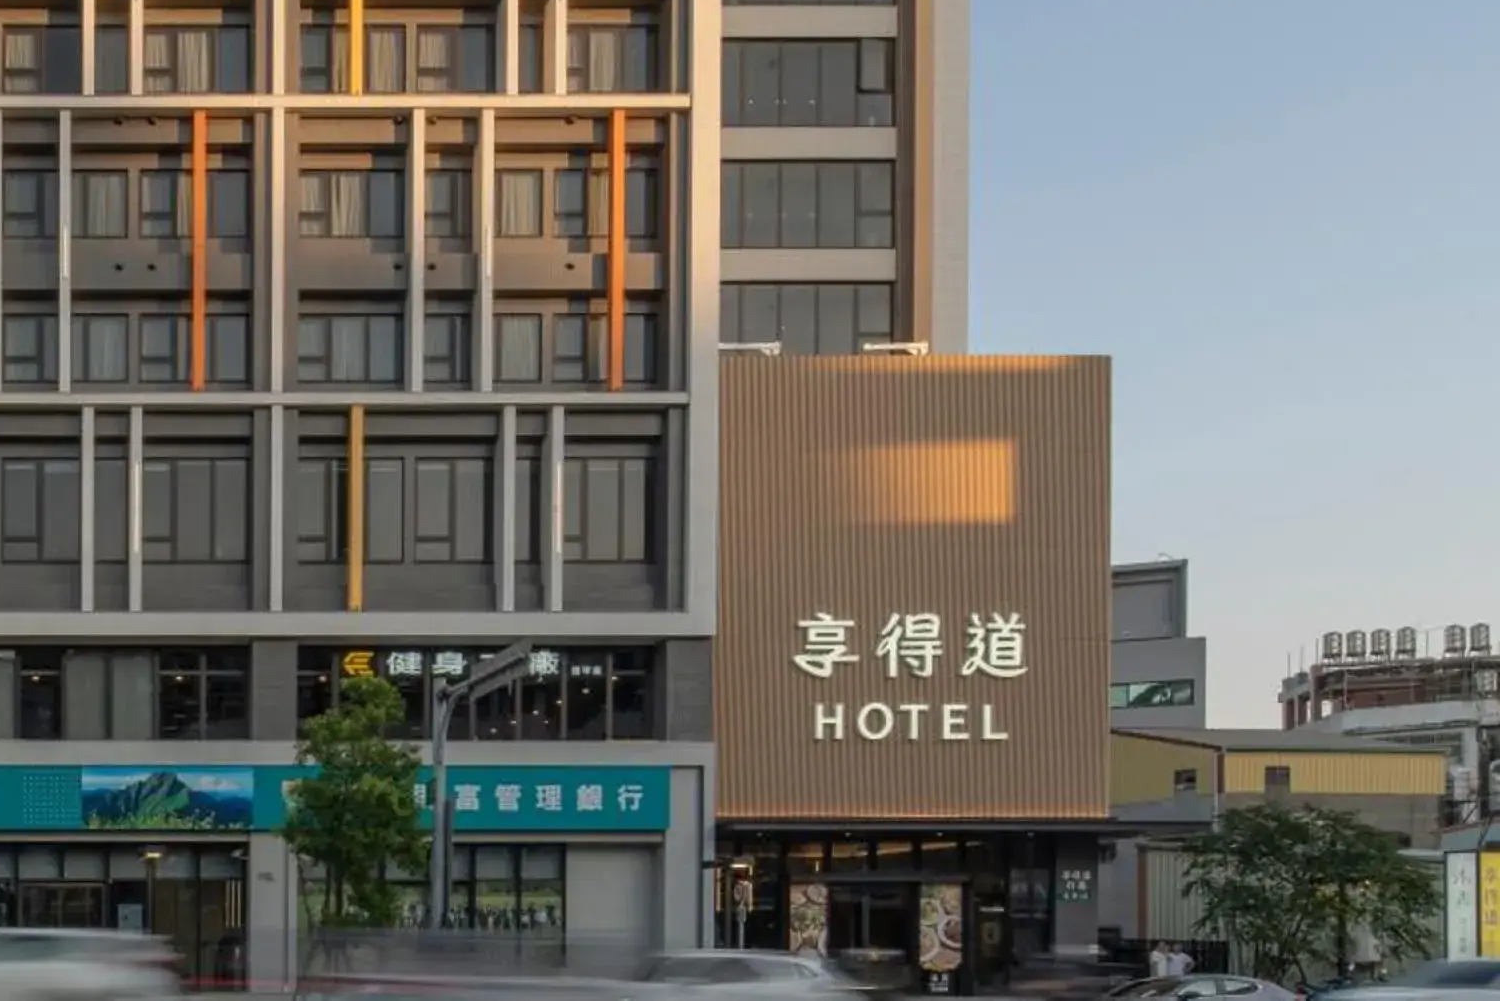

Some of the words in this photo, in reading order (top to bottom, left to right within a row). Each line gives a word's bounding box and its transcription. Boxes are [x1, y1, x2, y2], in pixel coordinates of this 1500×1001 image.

[386, 650, 560, 676] 健身廠
[793, 612, 1028, 678] 享得道
[814, 702, 1009, 740] HOTEL
